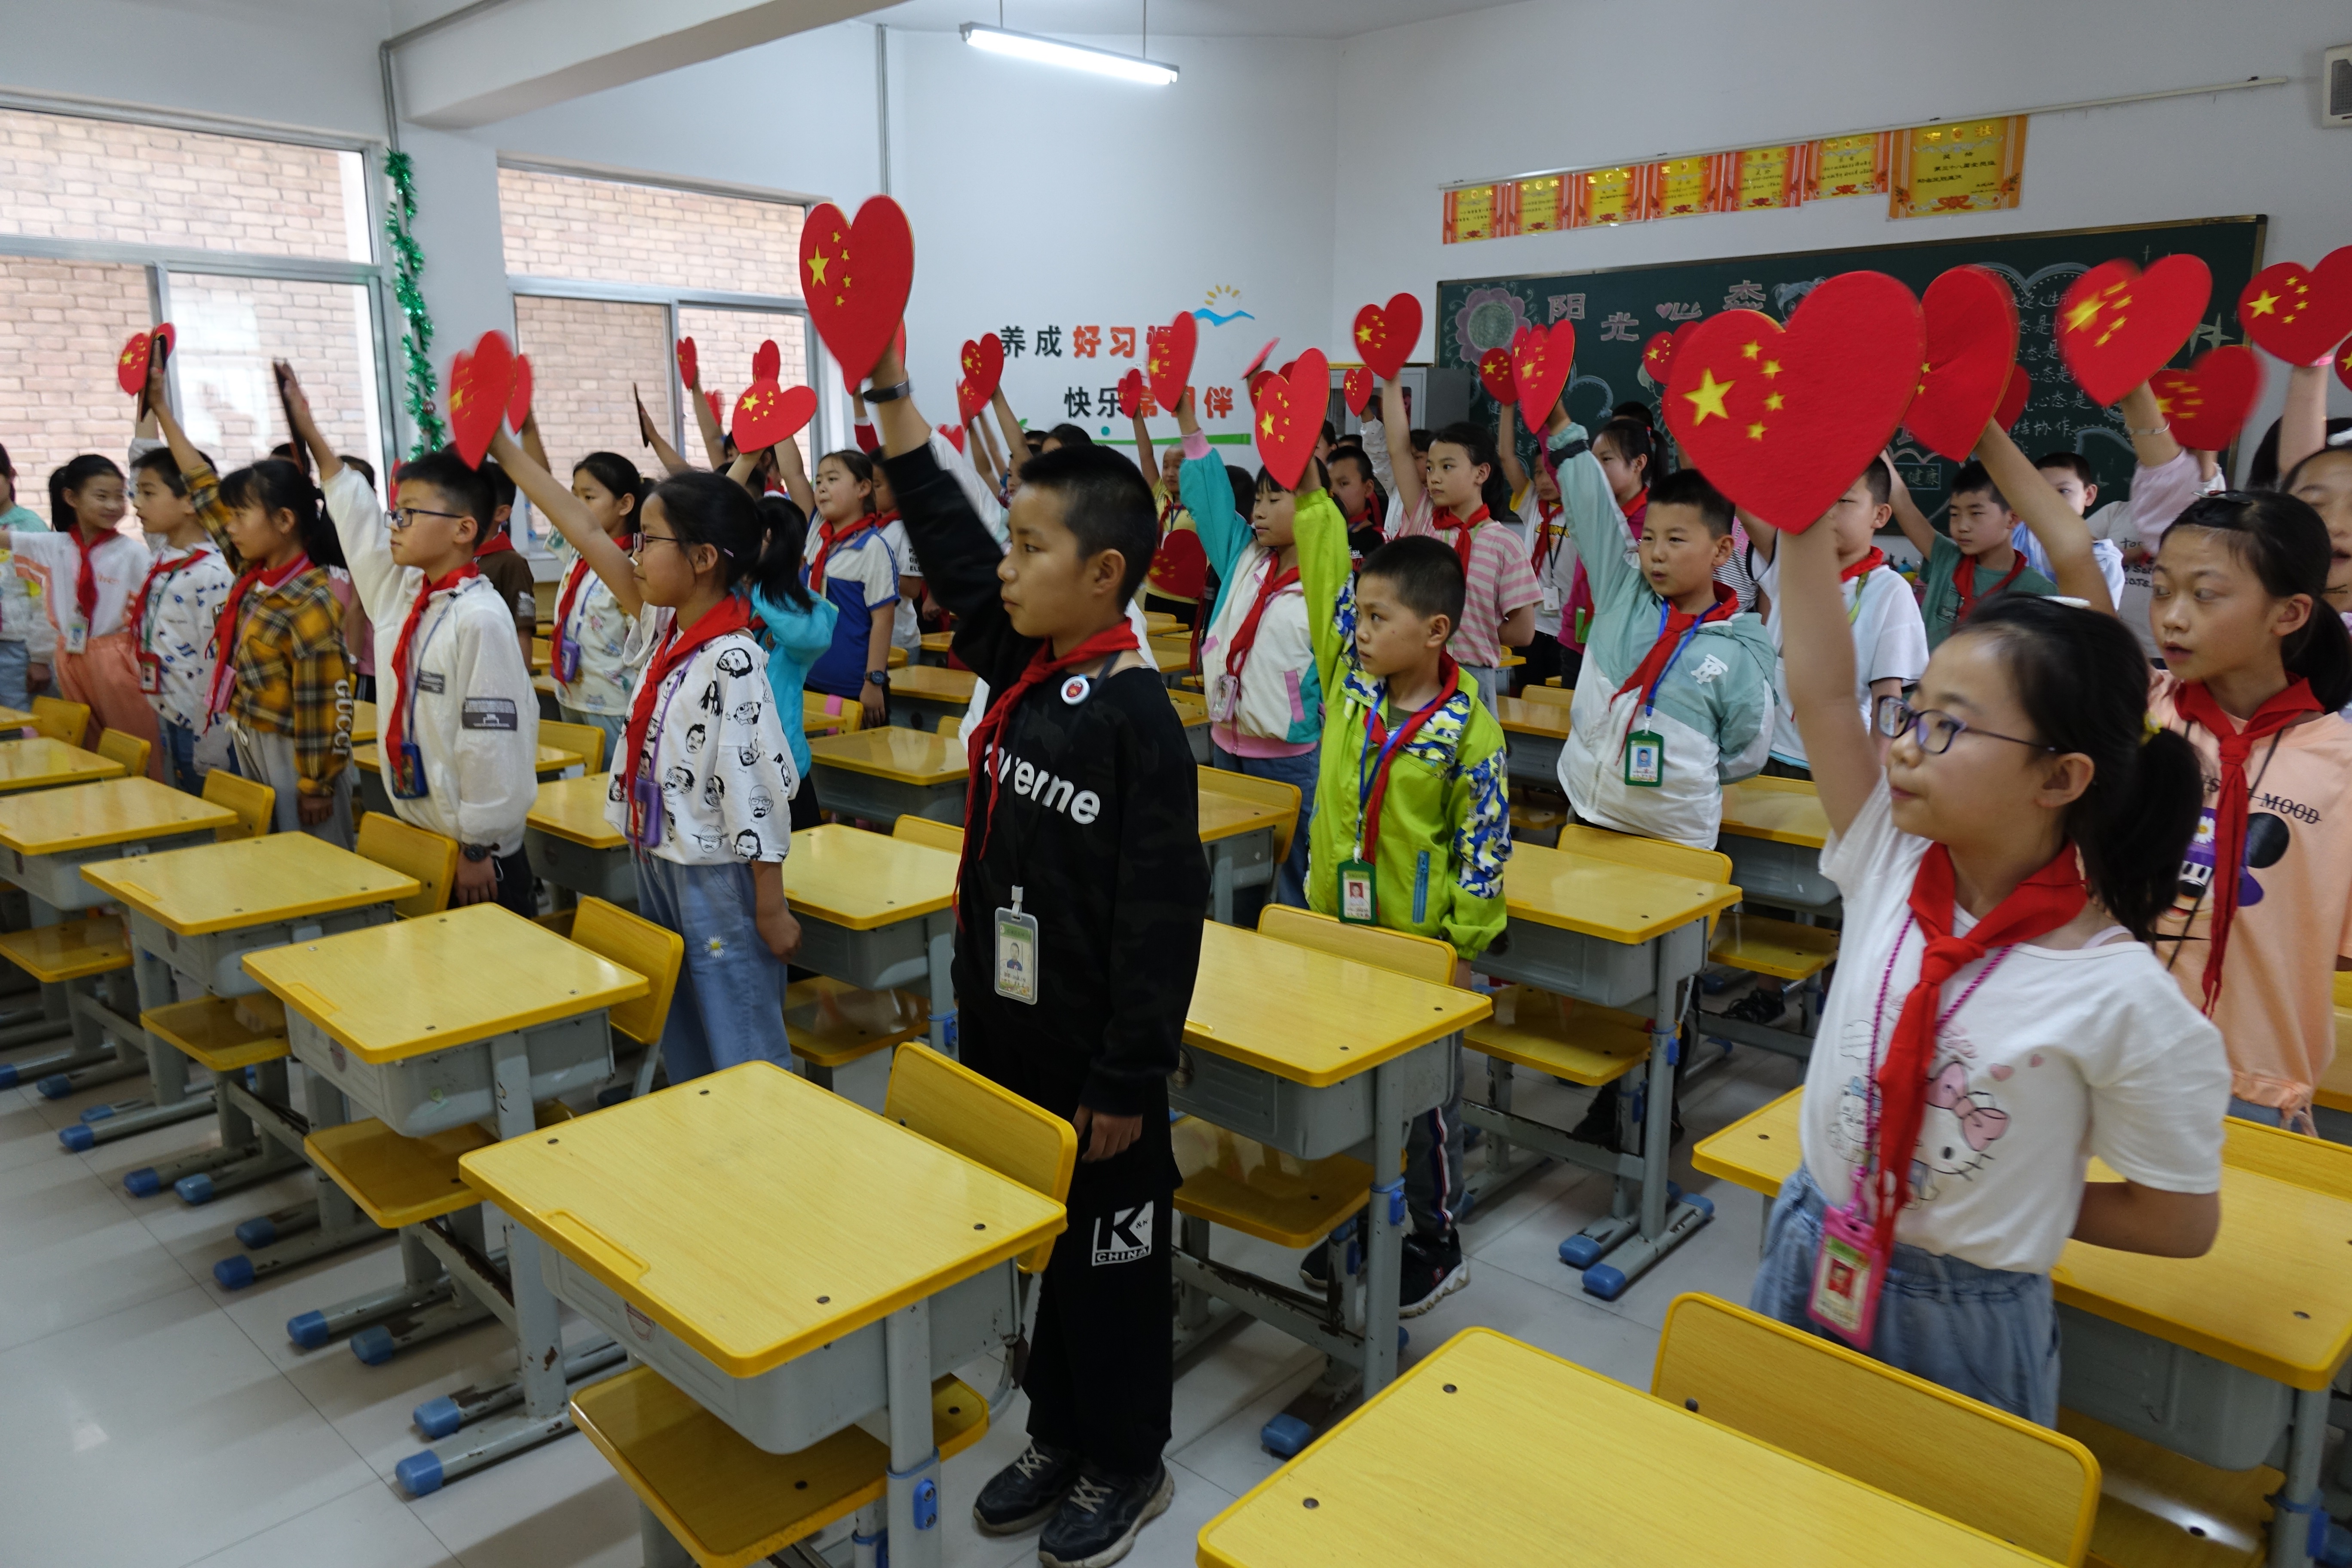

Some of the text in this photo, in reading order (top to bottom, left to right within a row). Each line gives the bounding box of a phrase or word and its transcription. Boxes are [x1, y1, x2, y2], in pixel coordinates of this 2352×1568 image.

[1064, 386, 1233, 419] 快乐常伴
[2259, 793, 2320, 824] MOOD
[1096, 1247, 1149, 1262] CHINA
